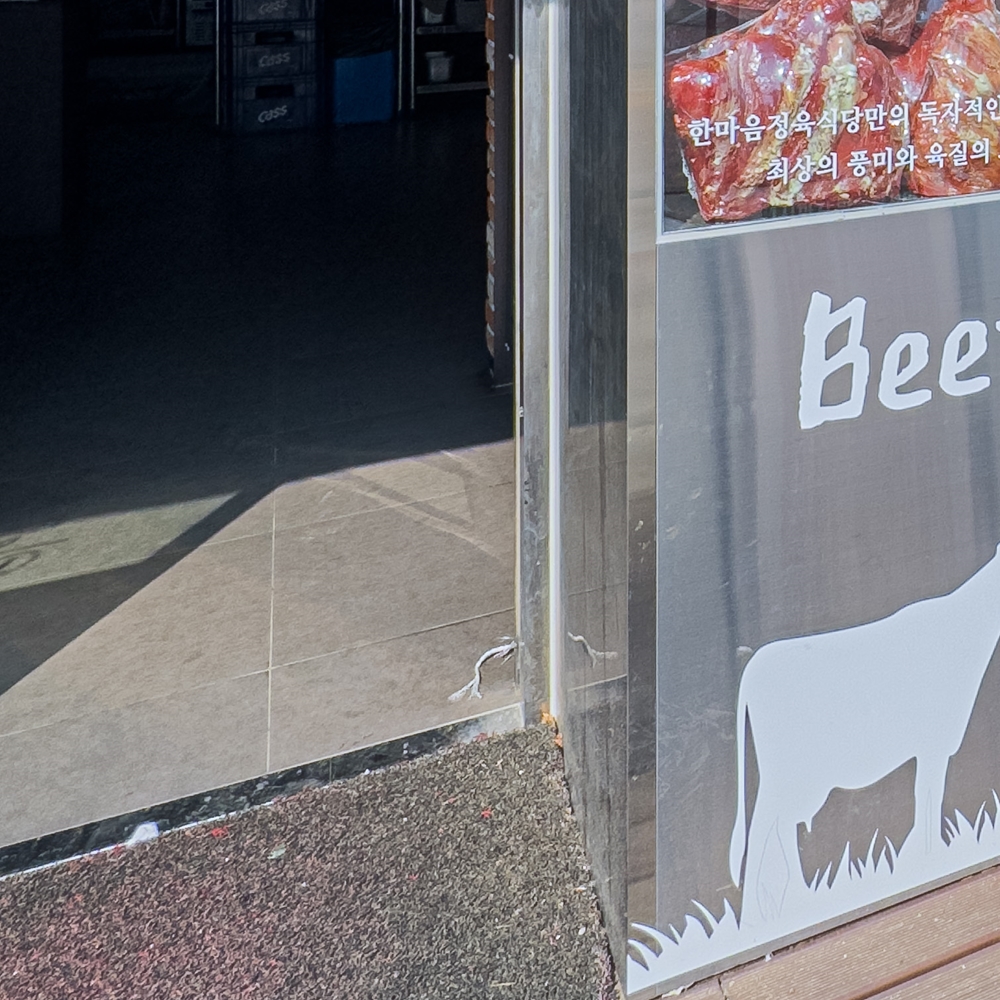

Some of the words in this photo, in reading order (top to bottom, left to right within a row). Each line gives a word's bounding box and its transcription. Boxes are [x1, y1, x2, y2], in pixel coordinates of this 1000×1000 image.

[688, 102, 909, 147] 한마음정육식당만의
[767, 153, 838, 184] 최상의
[848, 145, 918, 177] 풍미와
[925, 138, 990, 168] 육질의
